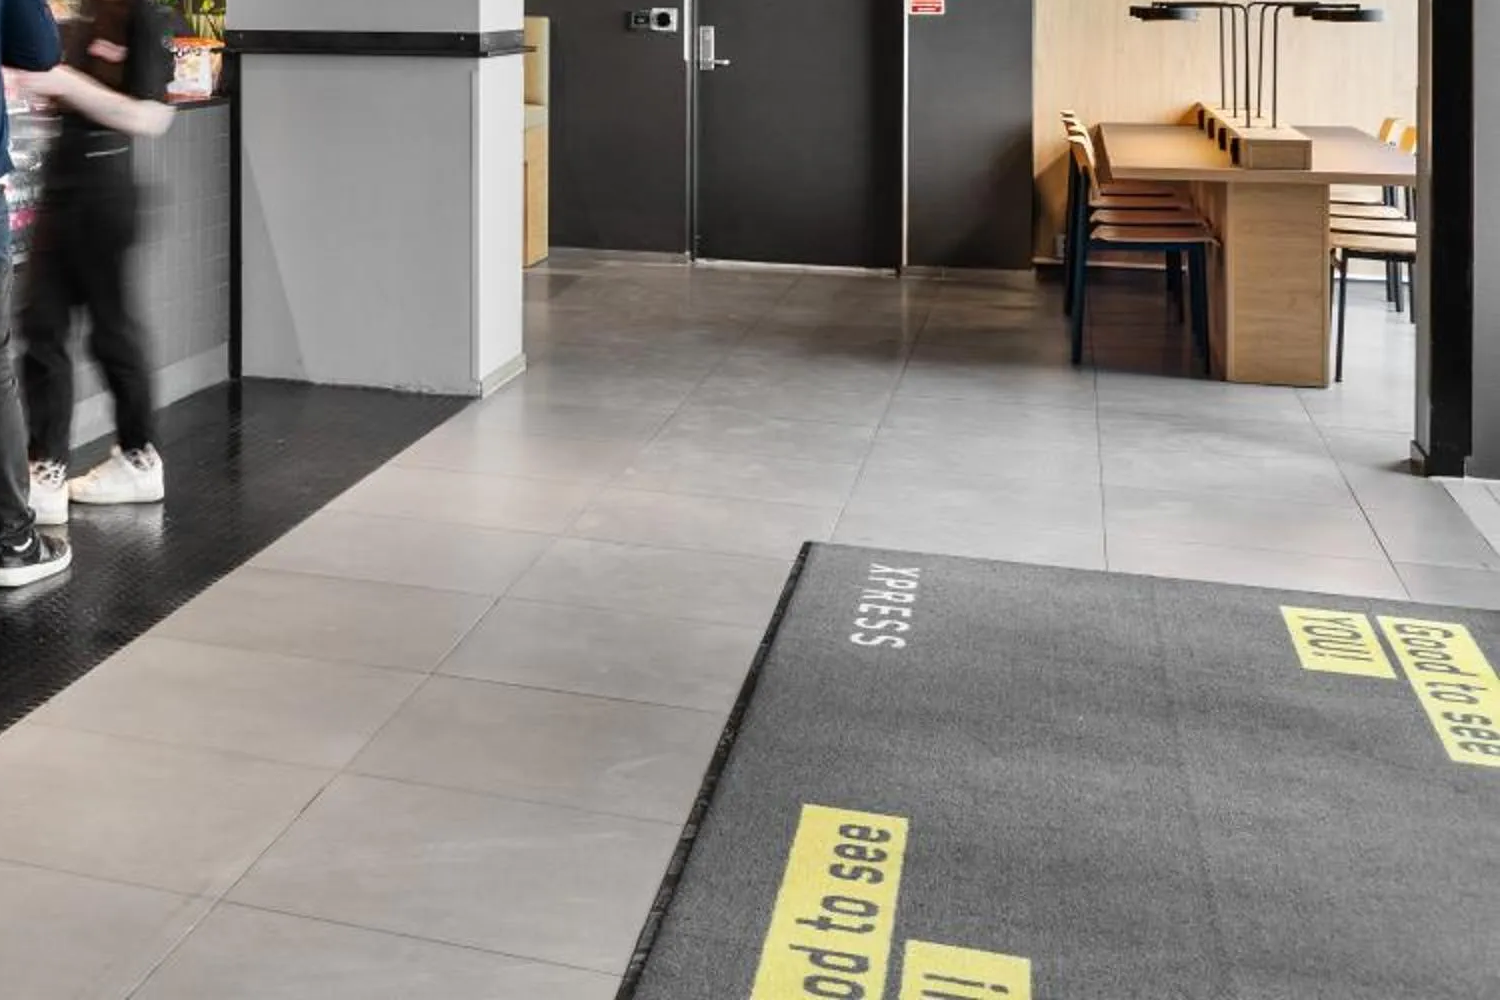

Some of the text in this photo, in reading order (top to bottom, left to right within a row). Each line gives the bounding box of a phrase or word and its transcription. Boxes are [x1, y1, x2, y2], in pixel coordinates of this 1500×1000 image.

[849, 563, 921, 649] XPRESS
[1296, 613, 1374, 663] YOU!
[1393, 623, 1500, 757] Good to see
[828, 822, 892, 885] see
[794, 894, 880, 935] to
